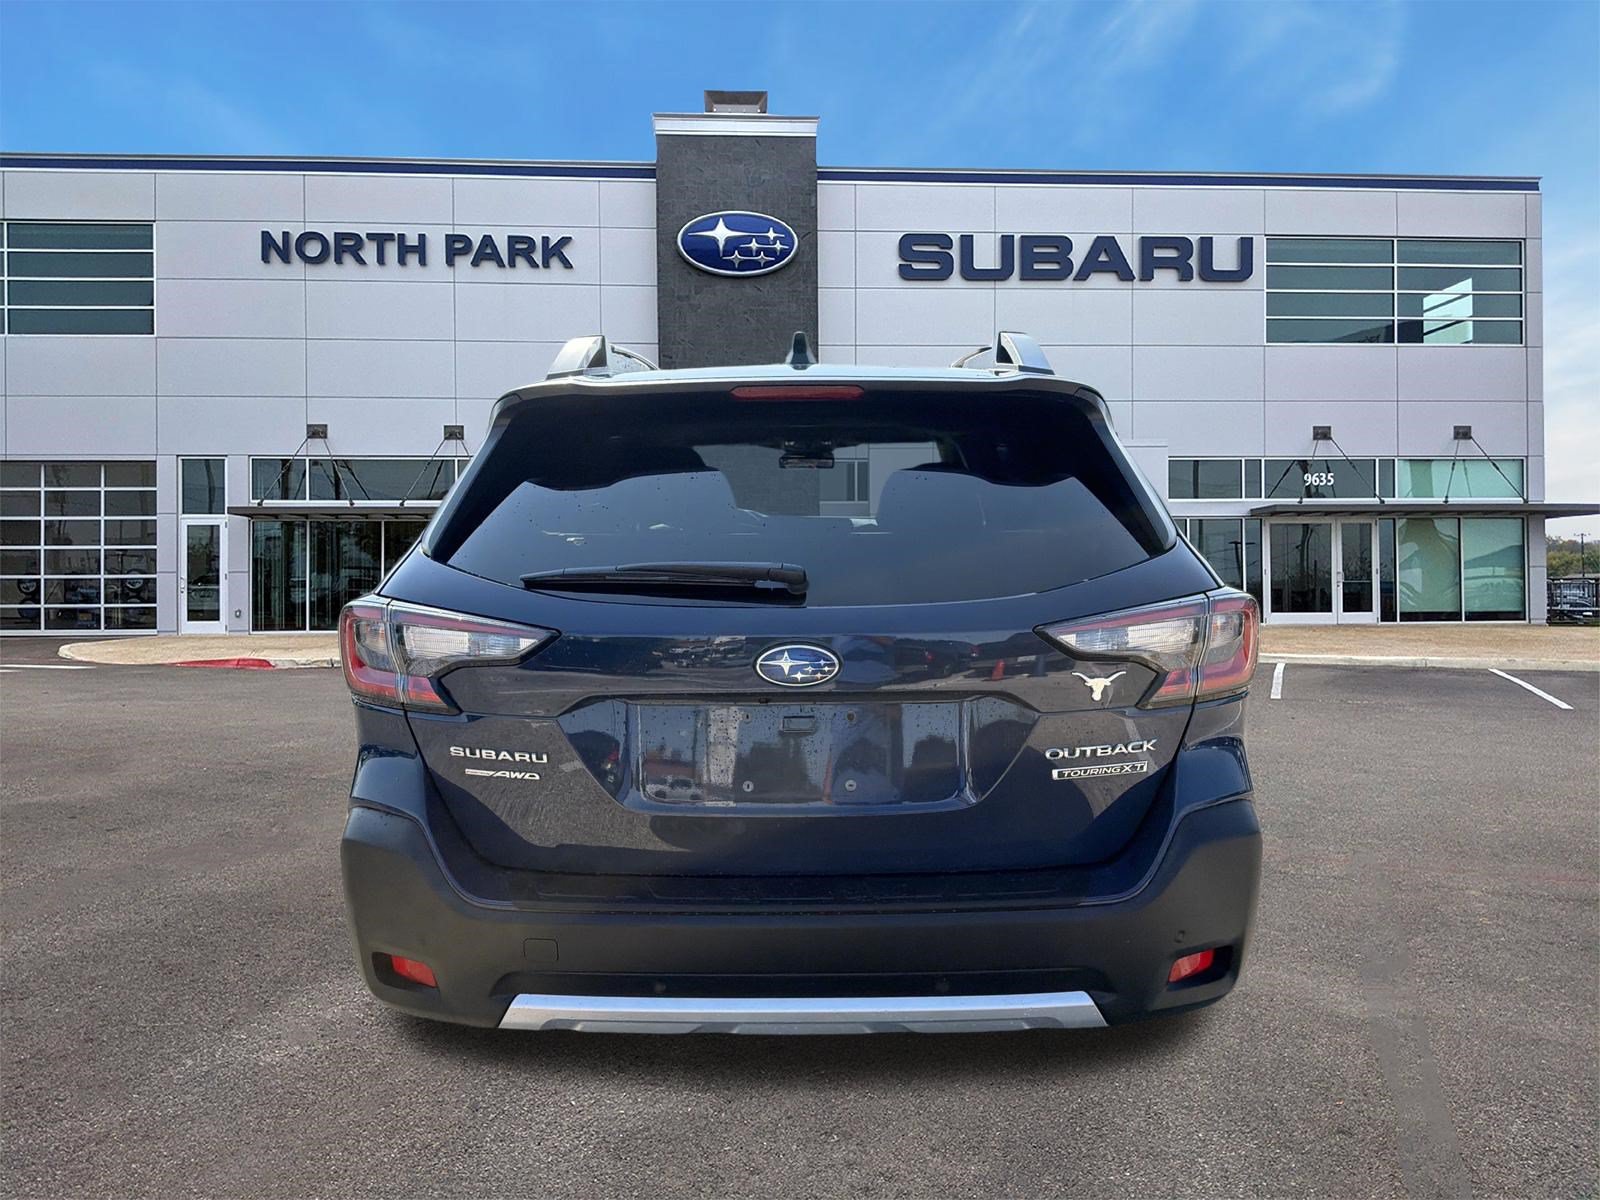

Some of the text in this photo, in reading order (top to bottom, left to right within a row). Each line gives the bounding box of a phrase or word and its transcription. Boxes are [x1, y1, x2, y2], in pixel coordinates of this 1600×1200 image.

[261, 230, 574, 270] NORTH PARK
[898, 232, 1254, 282] SUBARU
[1303, 472, 1335, 487] 9635
[449, 745, 549, 764] SUBARU
[1044, 739, 1157, 761] OUTBACK
[493, 770, 541, 781] AWD
